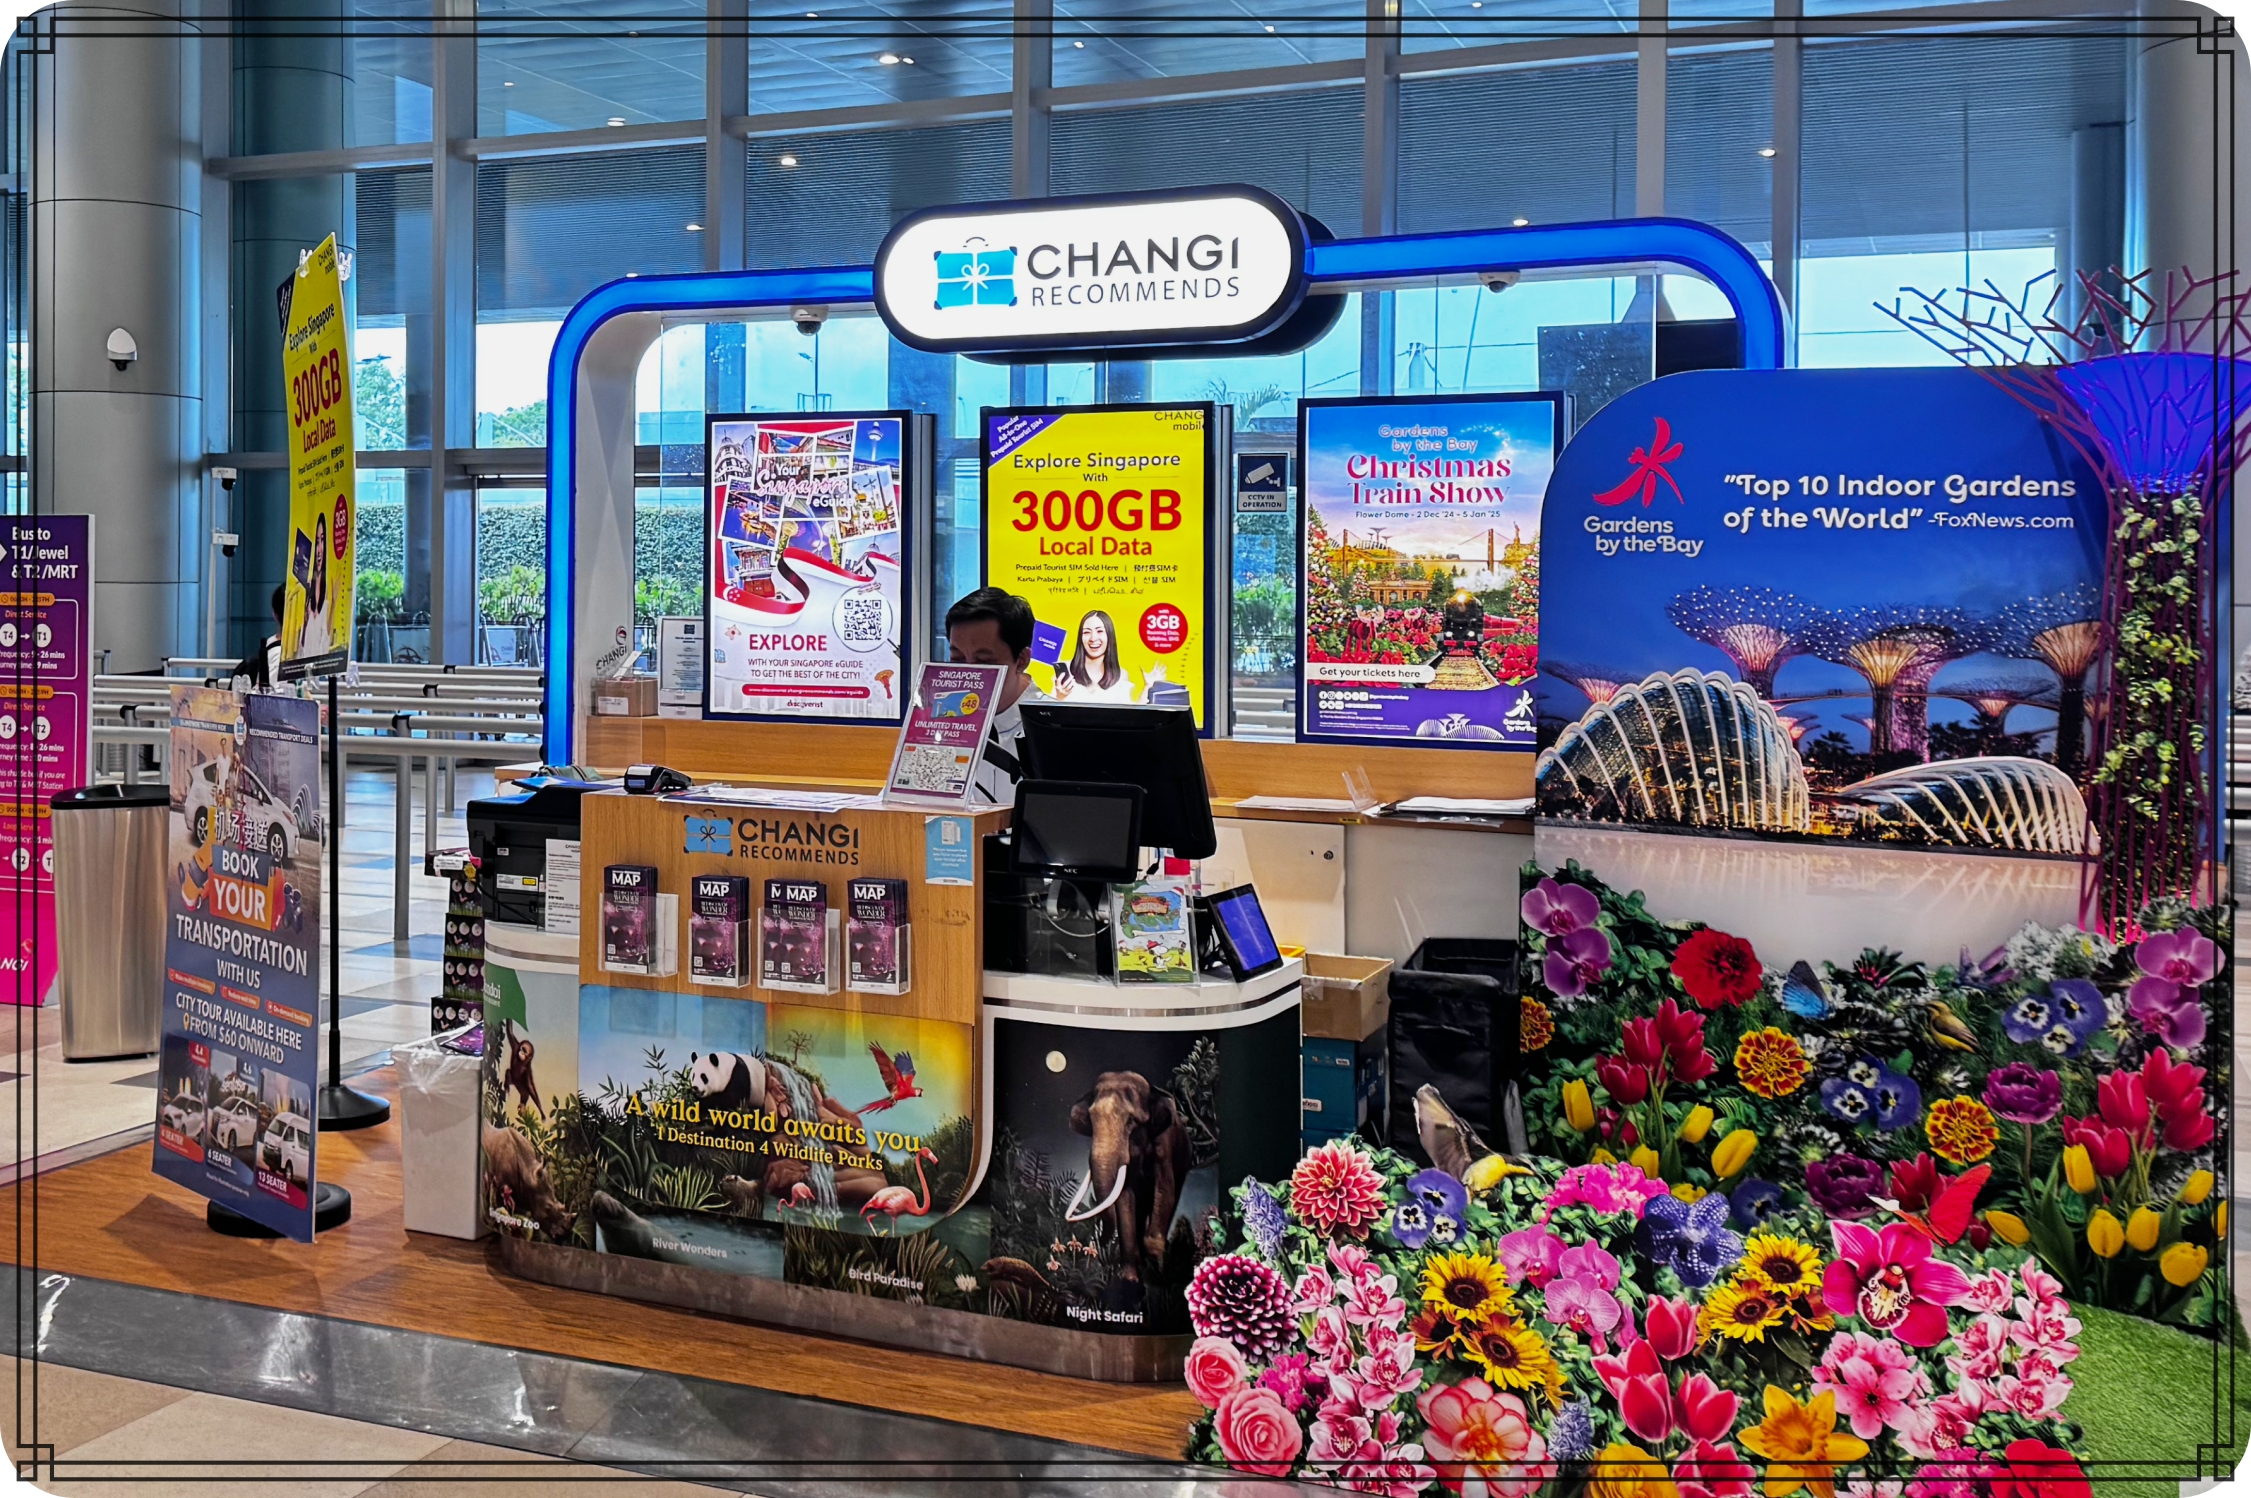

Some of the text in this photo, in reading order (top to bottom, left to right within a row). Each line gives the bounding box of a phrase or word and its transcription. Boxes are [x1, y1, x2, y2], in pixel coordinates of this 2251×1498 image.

[1027, 234, 1239, 280] CHANGI
[1032, 276, 1239, 307] RECOMMENDS
[289, 324, 308, 352] Explore
[308, 302, 335, 336] Singapore
[293, 348, 342, 428] 300GB
[303, 413, 337, 454] Local Data
[1378, 424, 1448, 438] Gardens
[1392, 438, 1479, 453] by the Bay
[775, 465, 801, 476] Your
[1013, 452, 1181, 473] Explore Singapore
[1347, 454, 1512, 480] Christmas
[1083, 473, 1108, 482] With
[756, 469, 848, 507] Singapore
[1347, 481, 1510, 505] Train Show
[1724, 473, 2077, 504] "Top 10 Indoor Gardens
[1012, 488, 1182, 532] 300GB
[1355, 511, 1382, 519] Flower
[1385, 511, 1409, 519] Dome
[1416, 511, 1422, 519] 2
[1423, 511, 1440, 519] Dec
[1462, 511, 1467, 519] 5
[1469, 511, 1486, 519] Jan
[1583, 515, 1674, 534] Gardens
[1723, 507, 1755, 534] of
[1760, 508, 1809, 529] the
[1812, 507, 1923, 530] World"
[12, 526, 51, 541] Bus to
[11, 544, 69, 560] T1/Jewel
[1040, 536, 1153, 556] Local Data
[1595, 534, 1704, 558] by the Bay
[11, 565, 22, 579] &
[1015, 564, 1042, 573] Prepaid
[1043, 564, 1067, 572] Tourist
[5, 610, 25, 619] Direct
[1146, 614, 1180, 630] 3GB
[3, 631, 14, 640] T4
[37, 631, 47, 641] T1
[749, 634, 828, 652] EXPLORE
[40, 651, 65, 660] 26 mins
[596, 645, 627, 670] CHANGI
[748, 658, 767, 666] WITH
[768, 659, 789, 667] YOUR
[790, 659, 833, 668] SINGAPORE
[42, 662, 58, 670] mins
[1319, 667, 1421, 679] Get your tickets here
[751, 669, 861, 680] TO GET THE BEST OF THE CITY!
[938, 670, 983, 681] SINGAPORE
[931, 678, 985, 690] TOURIST PASS
[2, 723, 12, 732] T4
[36, 724, 47, 734] T2
[914, 720, 978, 732] UNLIMITED TRAVEL,
[944, 730, 961, 738] PASS
[300, 735, 313, 744] DEALS
[39, 744, 64, 752] 26 mins
[42, 755, 59, 763] mins
[43, 772, 55, 780] you
[43, 781, 64, 790] Station
[737, 818, 859, 849] CHANGI
[15, 855, 26, 865] T2
[740, 844, 860, 866] RECOMMENDS
[222, 849, 260, 879] BOOK
[612, 871, 641, 886] MAP
[699, 882, 730, 897] MAP
[786, 888, 817, 902] MAP
[854, 886, 886, 900] MAP
[213, 878, 266, 923] YOUR
[176, 913, 308, 977] TRANSPORTATION
[0, 957, 29, 972] NGI
[217, 958, 245, 984] WITH
[246, 968, 261, 989] US
[176, 991, 302, 1051] CITY TOUR AVAILABLE HERE
[189, 1015, 217, 1040] FROM
[238, 1034, 285, 1065] ONWARD
[625, 1093, 921, 1156] A wild world awaits you
[165, 1131, 184, 1146] SEATER
[668, 1126, 755, 1153] Destination
[759, 1140, 769, 1155] 4
[772, 1140, 834, 1165] Wildlife
[838, 1154, 883, 1171] Parks
[212, 1151, 233, 1168] SEATER
[258, 1170, 266, 1182] 13
[266, 1173, 288, 1193] SEATER
[523, 1214, 541, 1230] Zoo
[652, 1237, 728, 1258] River Wonders
[849, 1268, 924, 1291] Bird Paradise
[1066, 1306, 1144, 1324] Night Safari
